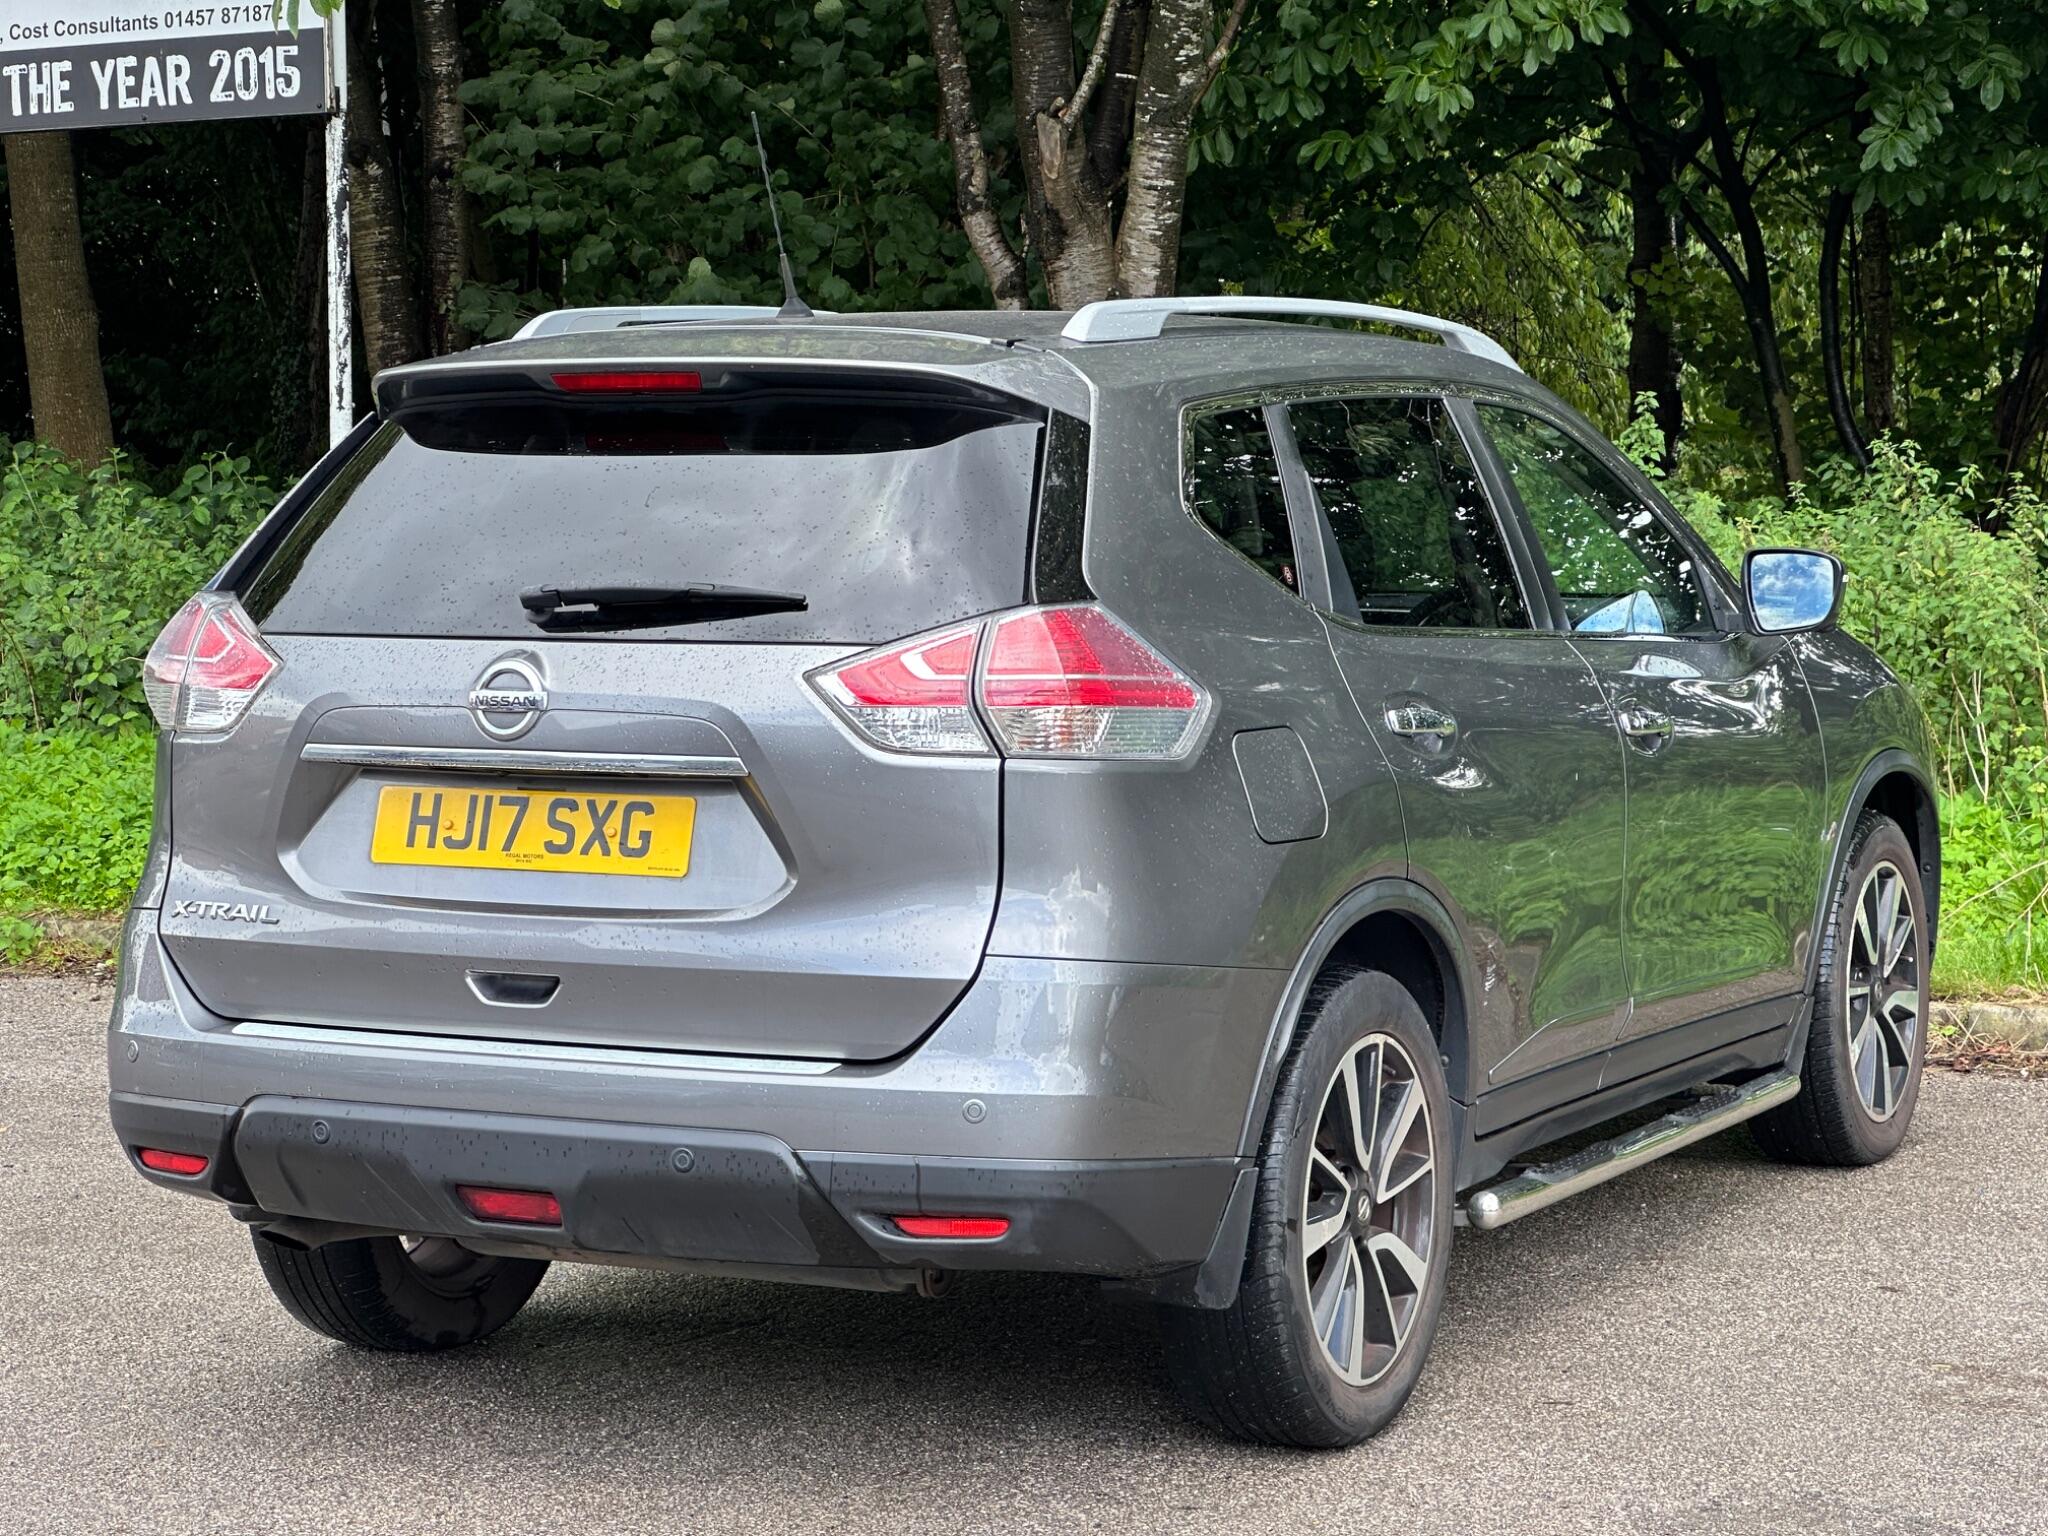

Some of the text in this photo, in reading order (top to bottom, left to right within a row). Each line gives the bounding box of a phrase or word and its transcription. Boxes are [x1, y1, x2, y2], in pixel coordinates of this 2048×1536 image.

[9, 21, 49, 41] Cost
[53, 14, 158, 37] Consultants
[164, 9, 214, 29] 01457
[221, 3, 283, 25] 87187
[2, 45, 302, 117] THE YEAR 2015
[474, 694, 537, 707] NISSAN
[405, 792, 656, 859] HJ17 SXG
[172, 899, 280, 925] X-TRAIL
